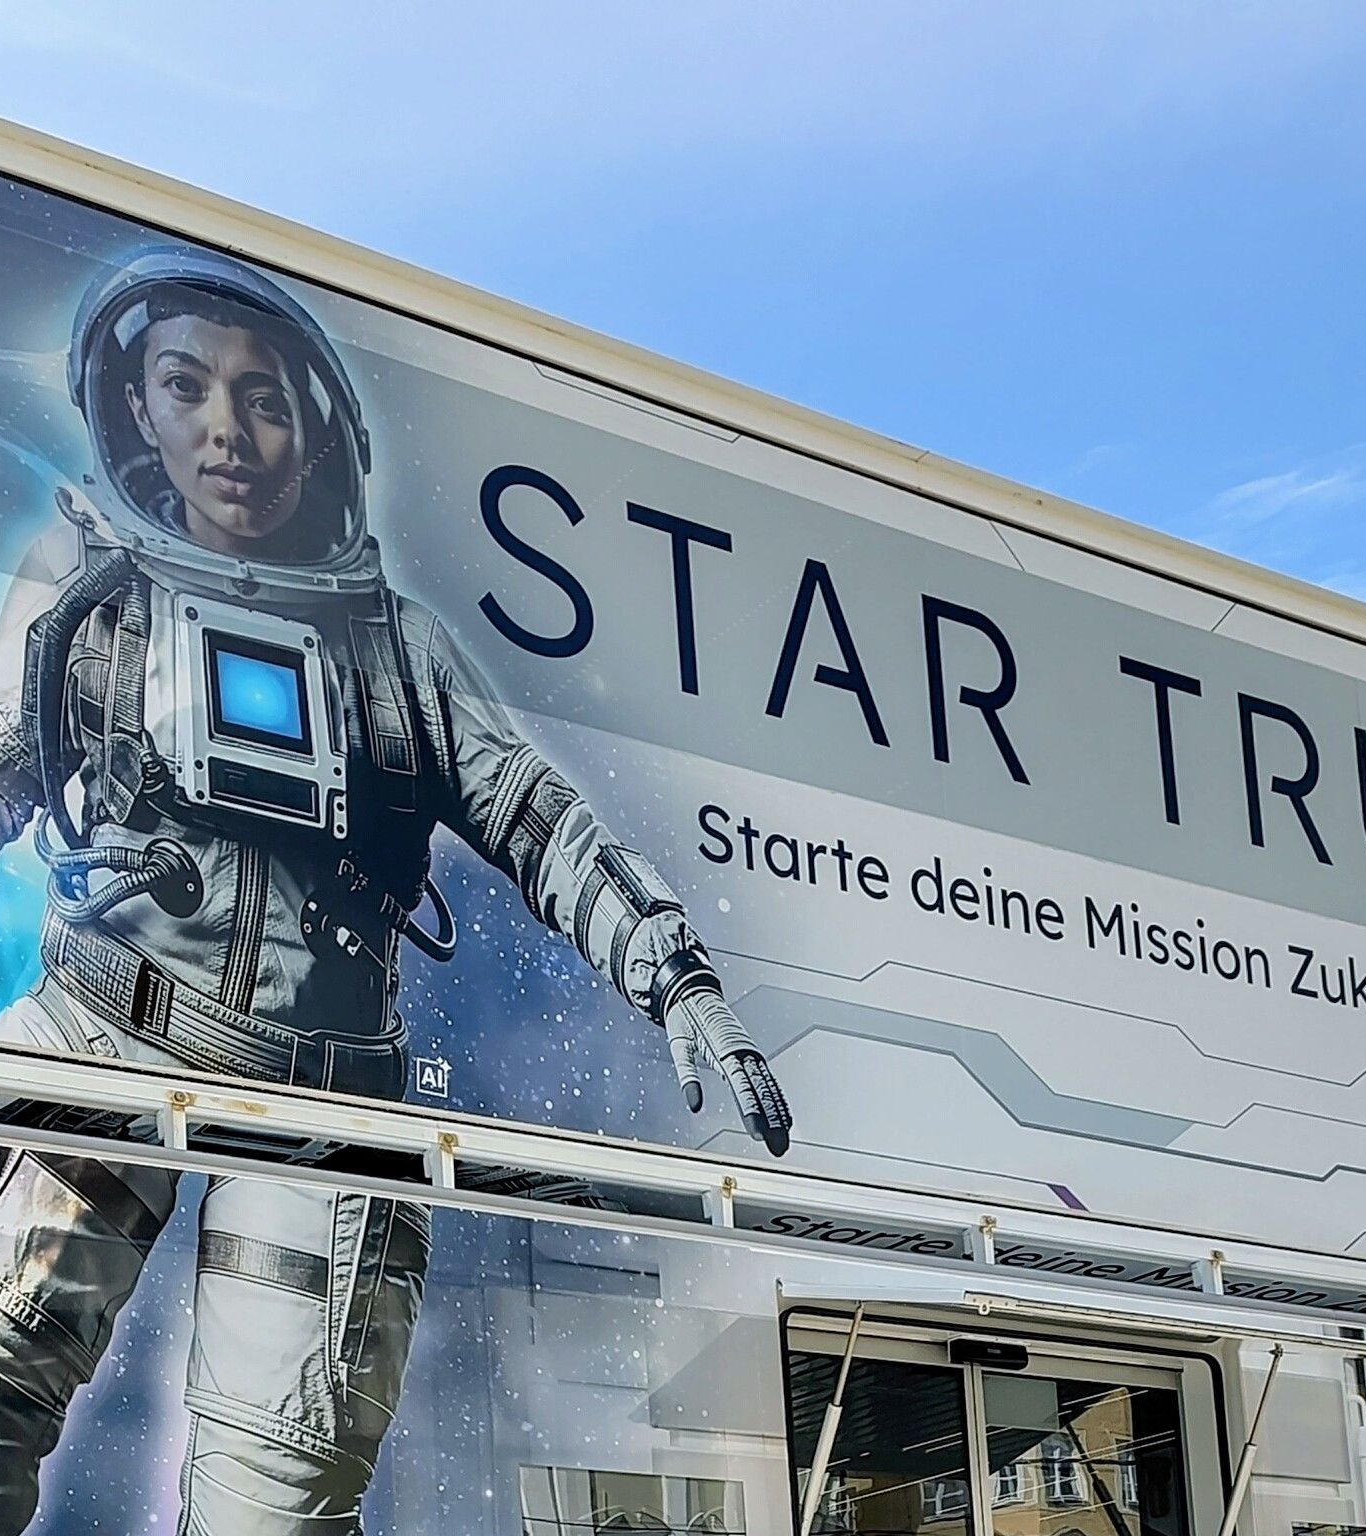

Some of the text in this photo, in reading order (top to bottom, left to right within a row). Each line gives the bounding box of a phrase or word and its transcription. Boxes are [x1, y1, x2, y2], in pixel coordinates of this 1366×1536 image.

[478, 463, 1031, 786] STAR
[697, 803, 891, 901] Starte
[911, 854, 1065, 942] deine
[1085, 897, 1272, 992] Mission
[421, 1066, 443, 1088] AI
[752, 1214, 955, 1256] Starte
